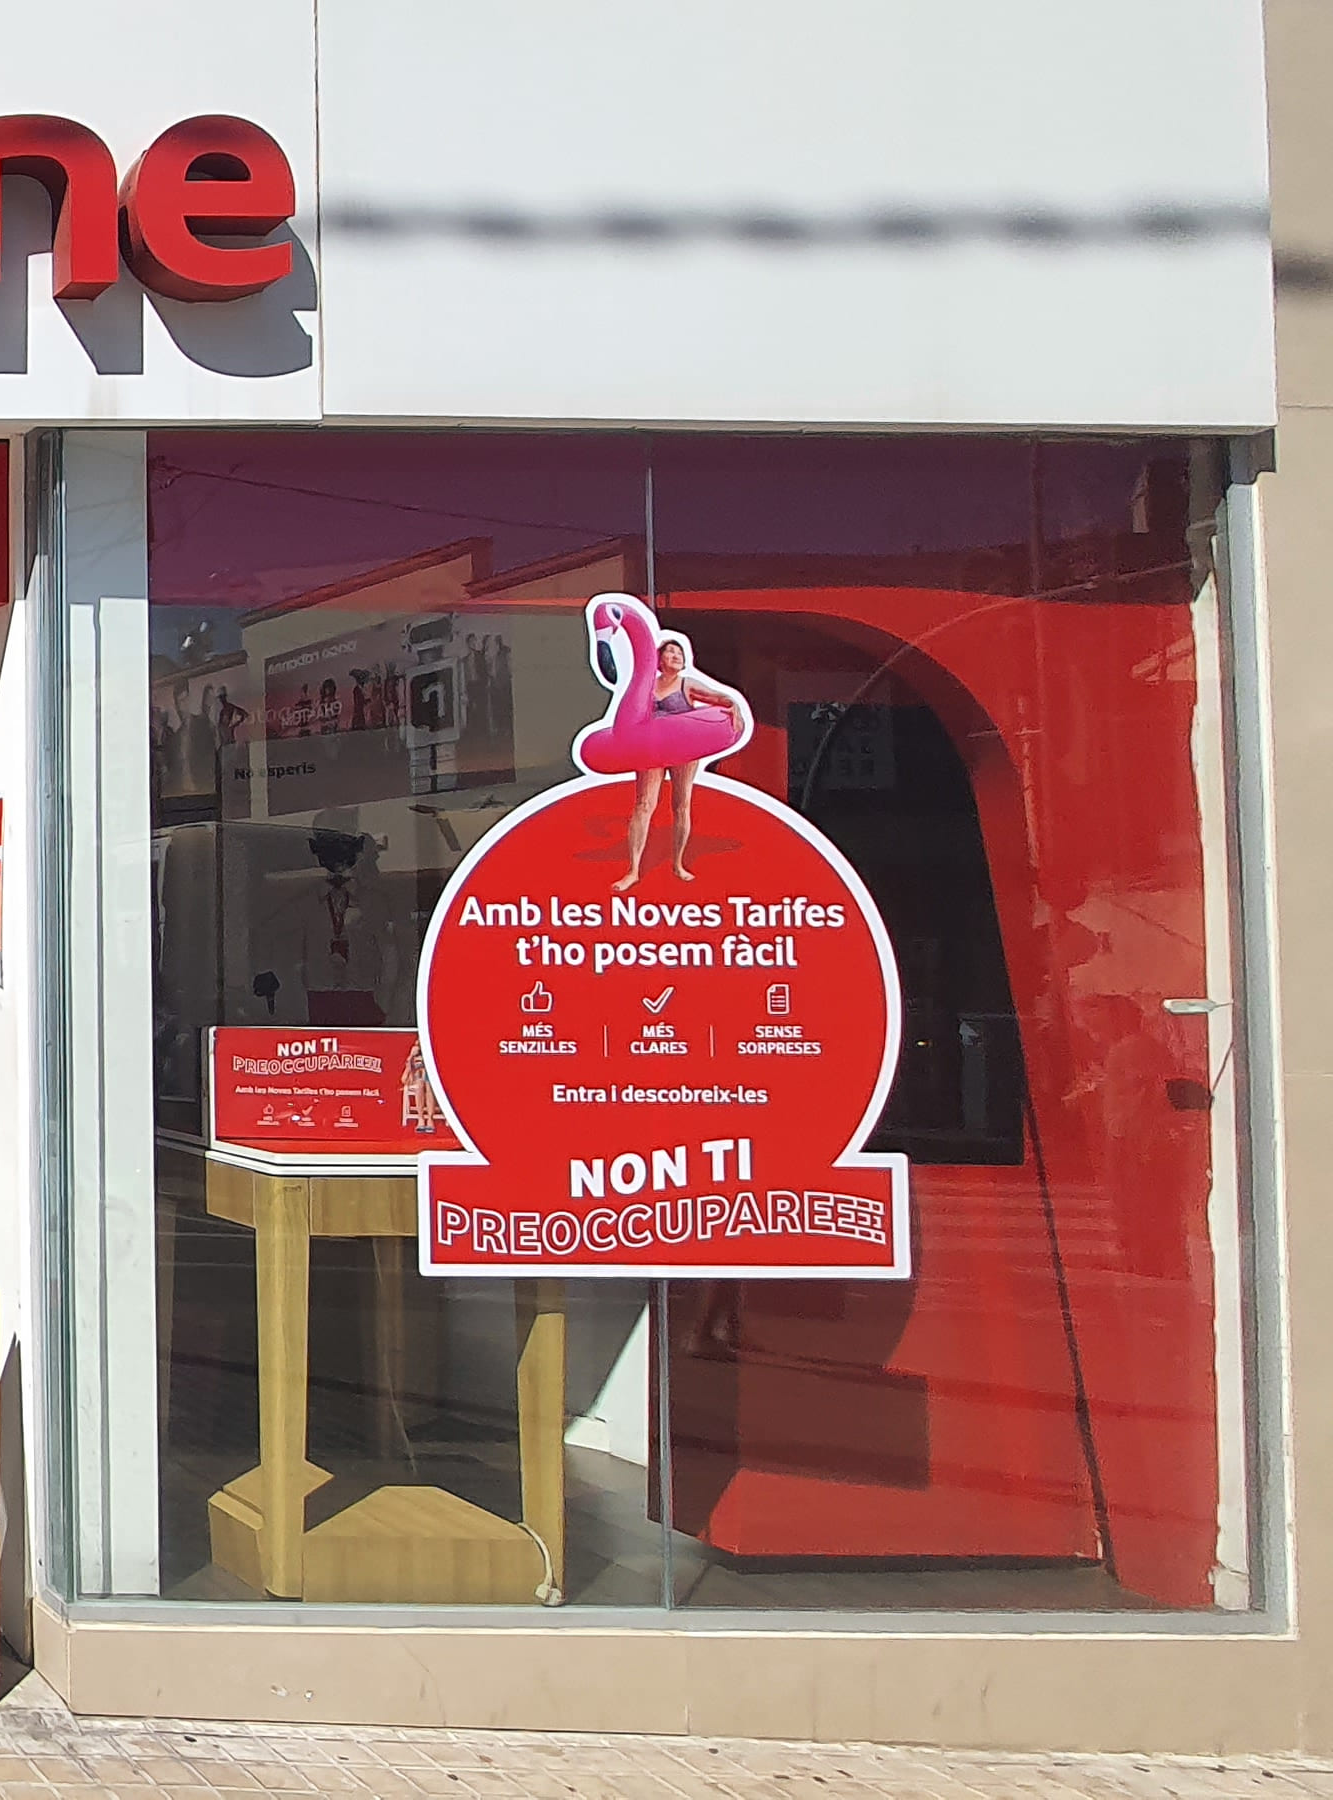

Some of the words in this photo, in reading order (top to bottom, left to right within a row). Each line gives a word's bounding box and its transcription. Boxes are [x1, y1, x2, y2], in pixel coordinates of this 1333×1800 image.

[459, 896, 542, 928] Amb
[551, 896, 603, 928] les
[610, 896, 722, 928] Noves
[728, 896, 845, 928] Tarifes
[516, 935, 585, 966] t'ho
[594, 941, 713, 974] posem
[721, 934, 798, 967] fàcil
[522, 1022, 553, 1038] MÉS
[642, 1022, 675, 1038] MÉS
[754, 1025, 803, 1039] SENSE
[277, 1040, 316, 1056] NON
[320, 1037, 338, 1053] TI
[499, 1041, 577, 1055] SENZILLES
[630, 1041, 688, 1055] CLARES
[737, 1041, 822, 1055] SORPRESES
[552, 1085, 606, 1103] Entra
[610, 1084, 617, 1103] i
[621, 1084, 768, 1104] descobreix-les
[570, 1145, 688, 1198] NON
[701, 1138, 752, 1183] TI
